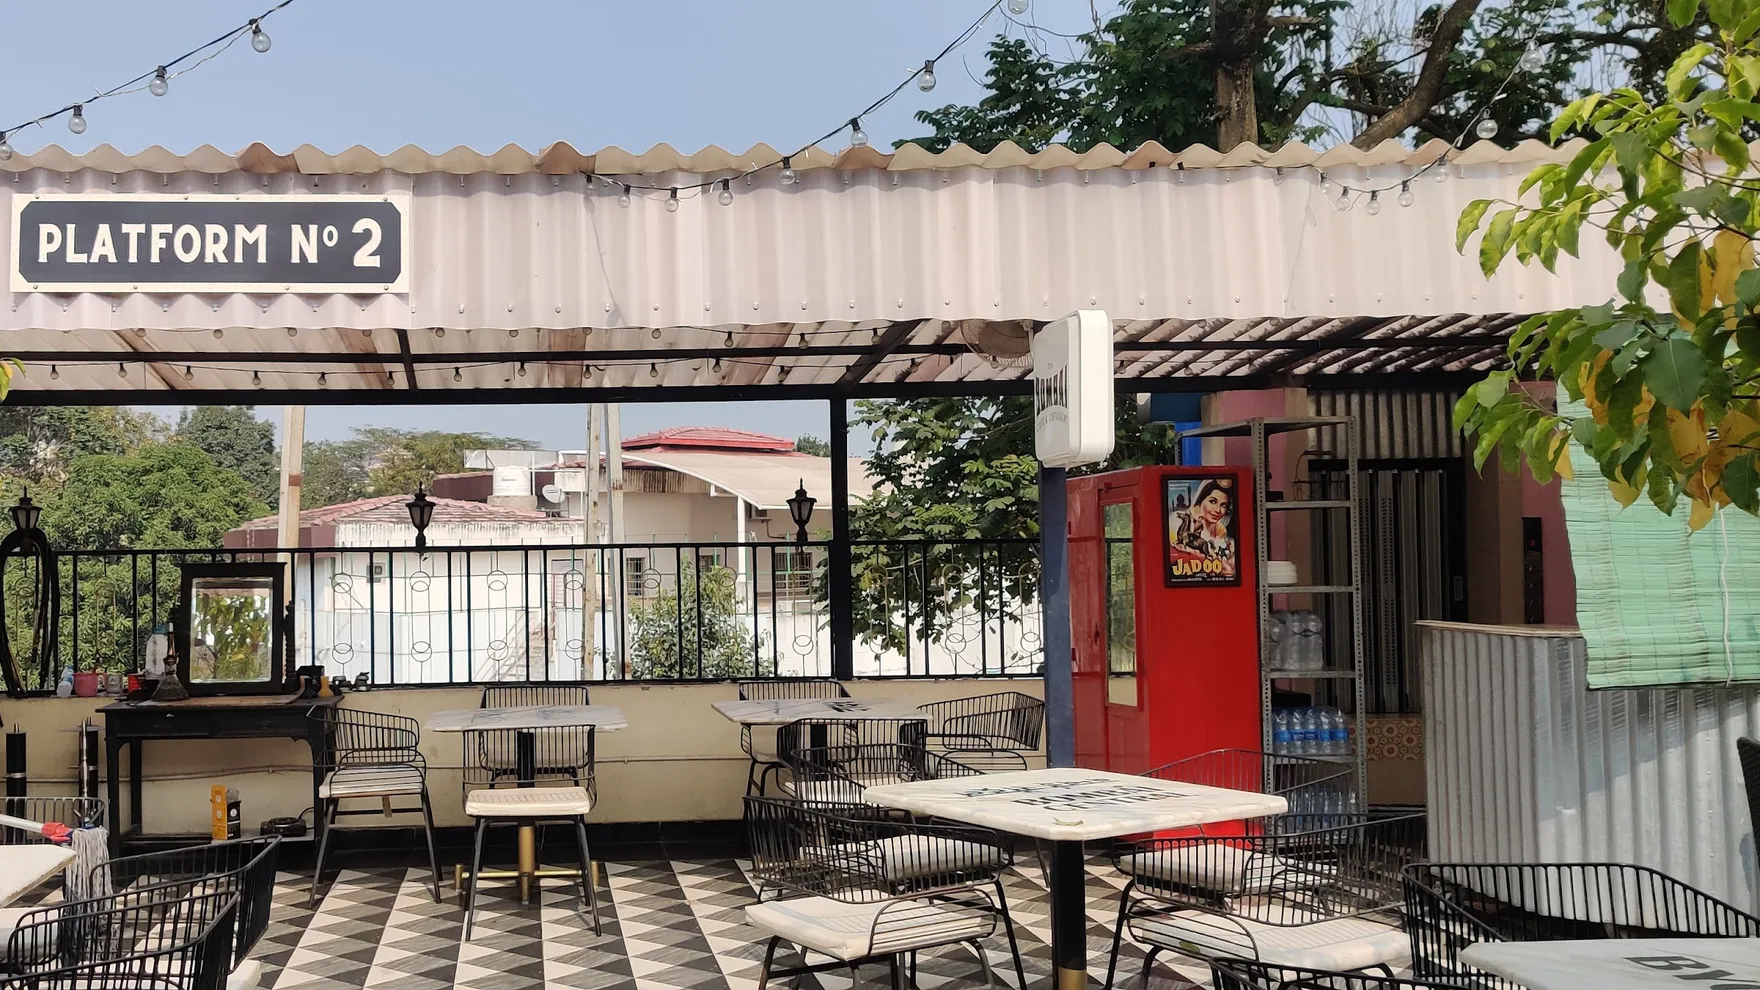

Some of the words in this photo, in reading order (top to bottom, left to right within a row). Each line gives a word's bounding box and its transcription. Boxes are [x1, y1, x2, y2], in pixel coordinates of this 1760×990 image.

[37, 222, 268, 264] PLATFORM
[350, 217, 383, 269] 2
[1171, 558, 1223, 576] JADOO
[1043, 791, 1190, 812] CENTRAL
